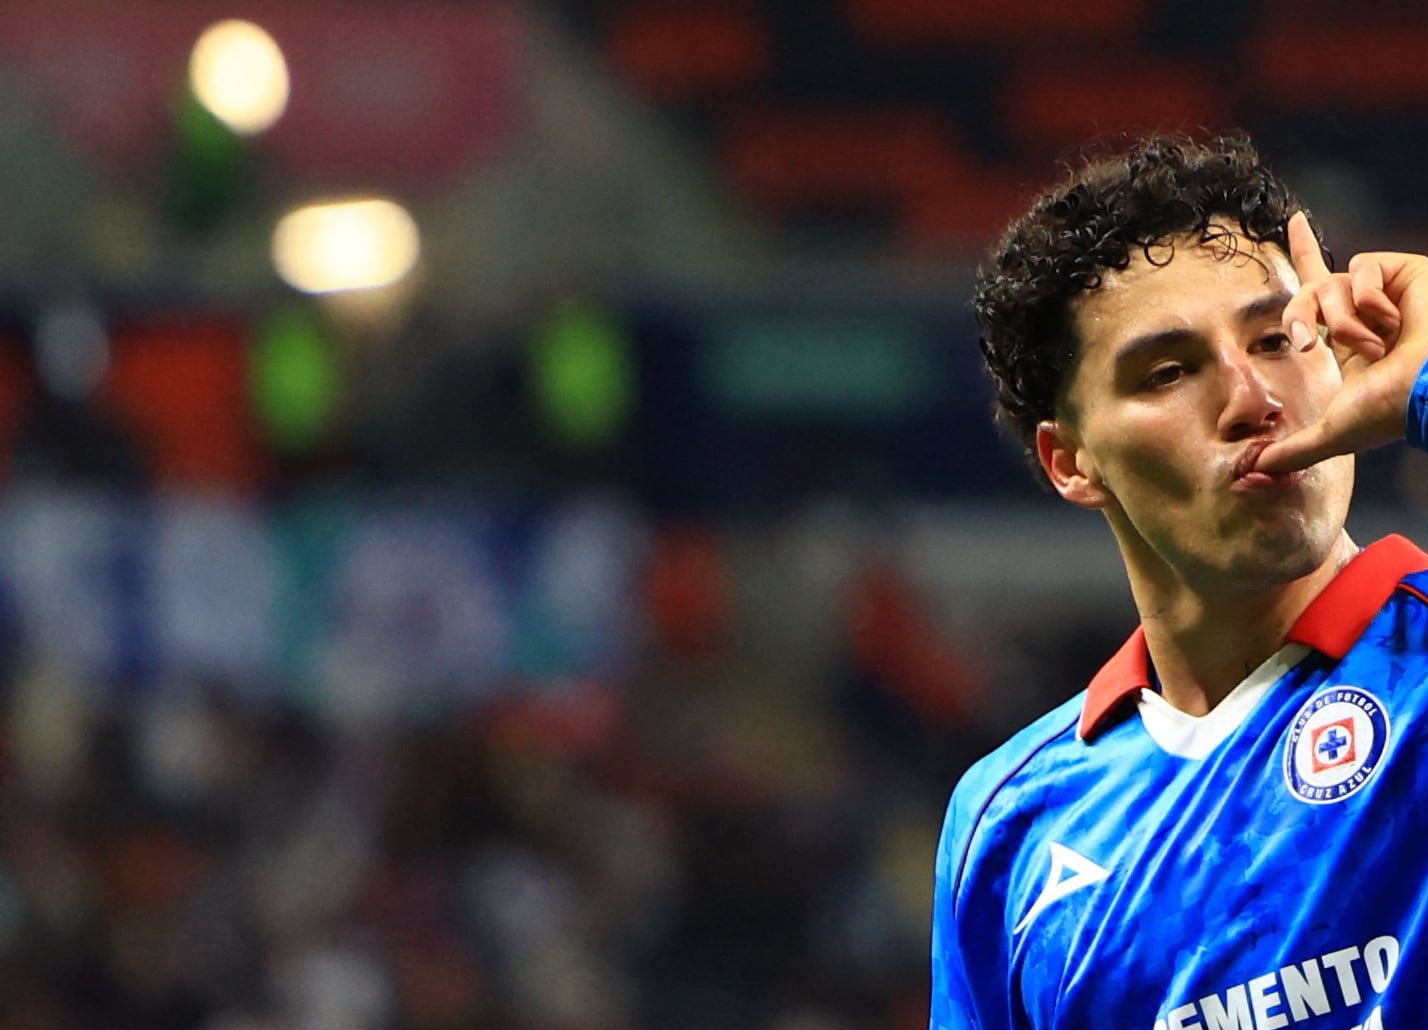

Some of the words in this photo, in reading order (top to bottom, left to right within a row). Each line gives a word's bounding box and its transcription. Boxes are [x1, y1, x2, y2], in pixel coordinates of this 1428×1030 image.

[1315, 695, 1330, 709] DE
[1300, 784, 1332, 799] CRUZ
[1338, 765, 1372, 795] AZUL
